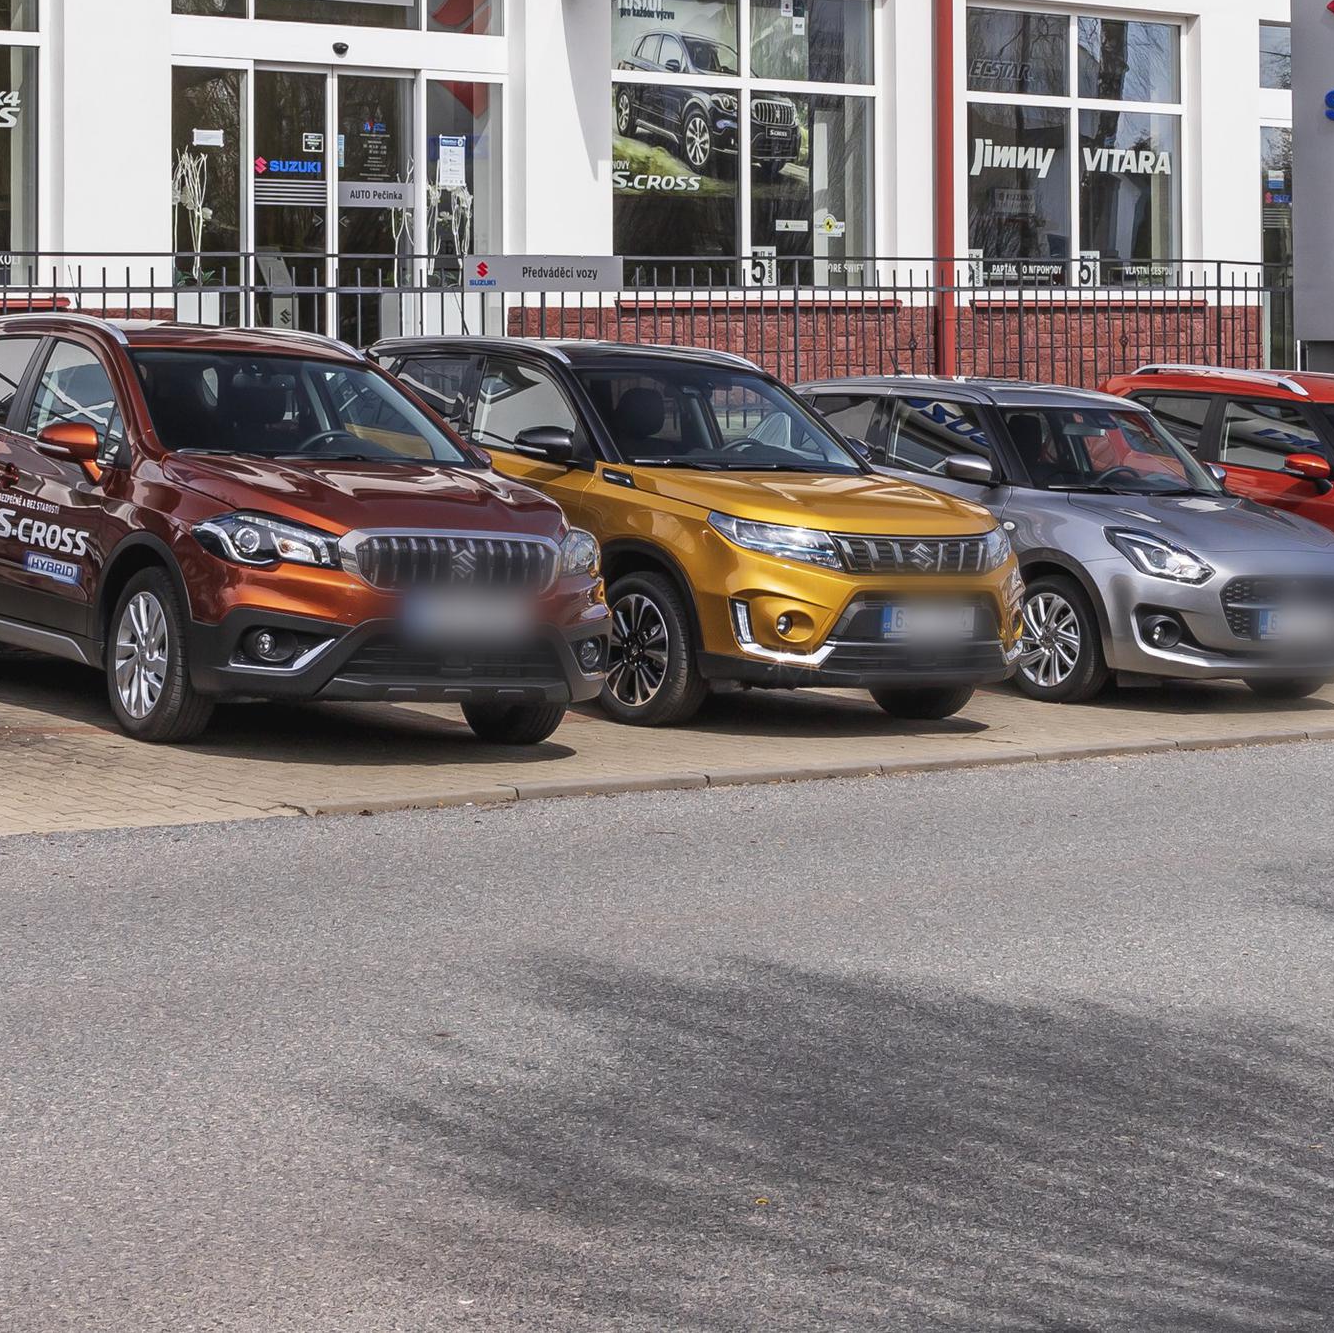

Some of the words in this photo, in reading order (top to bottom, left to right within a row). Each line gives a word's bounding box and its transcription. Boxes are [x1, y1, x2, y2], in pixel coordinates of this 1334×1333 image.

[968, 58, 1034, 81] ECSTAR
[269, 160, 322, 173] SUZUKI
[969, 138, 1056, 179] Jimny
[1082, 147, 1172, 175] VITARA
[349, 189, 370, 199] AUTO
[372, 189, 403, 201] Pečinka
[522, 266, 574, 279] Předváděcí
[576, 268, 598, 280] vozy
[30, 556, 74, 578] HYBRID
